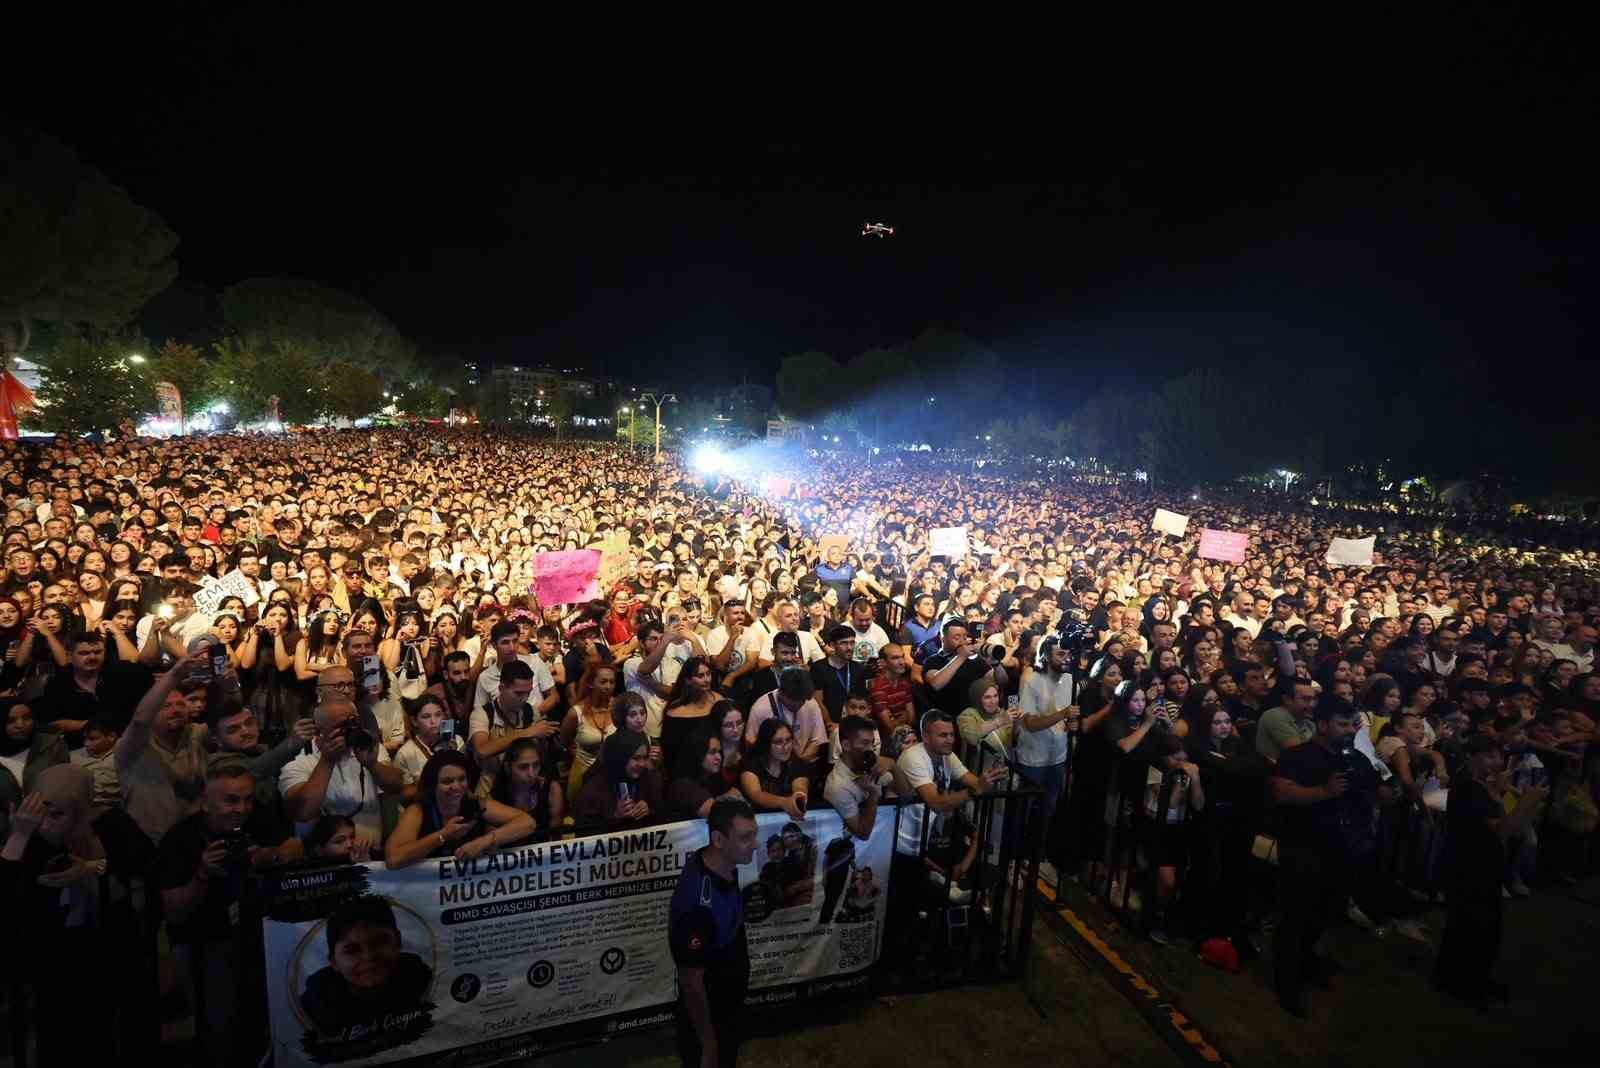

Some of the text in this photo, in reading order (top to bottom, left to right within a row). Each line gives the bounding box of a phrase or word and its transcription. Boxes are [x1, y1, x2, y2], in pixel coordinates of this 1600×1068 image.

[440, 830, 673, 880] EVLADIN EVLADIMIZ,
[440, 863, 581, 906] MÜCADELESİ
[453, 909, 480, 921] DMD
[576, 889, 602, 901] BERK
